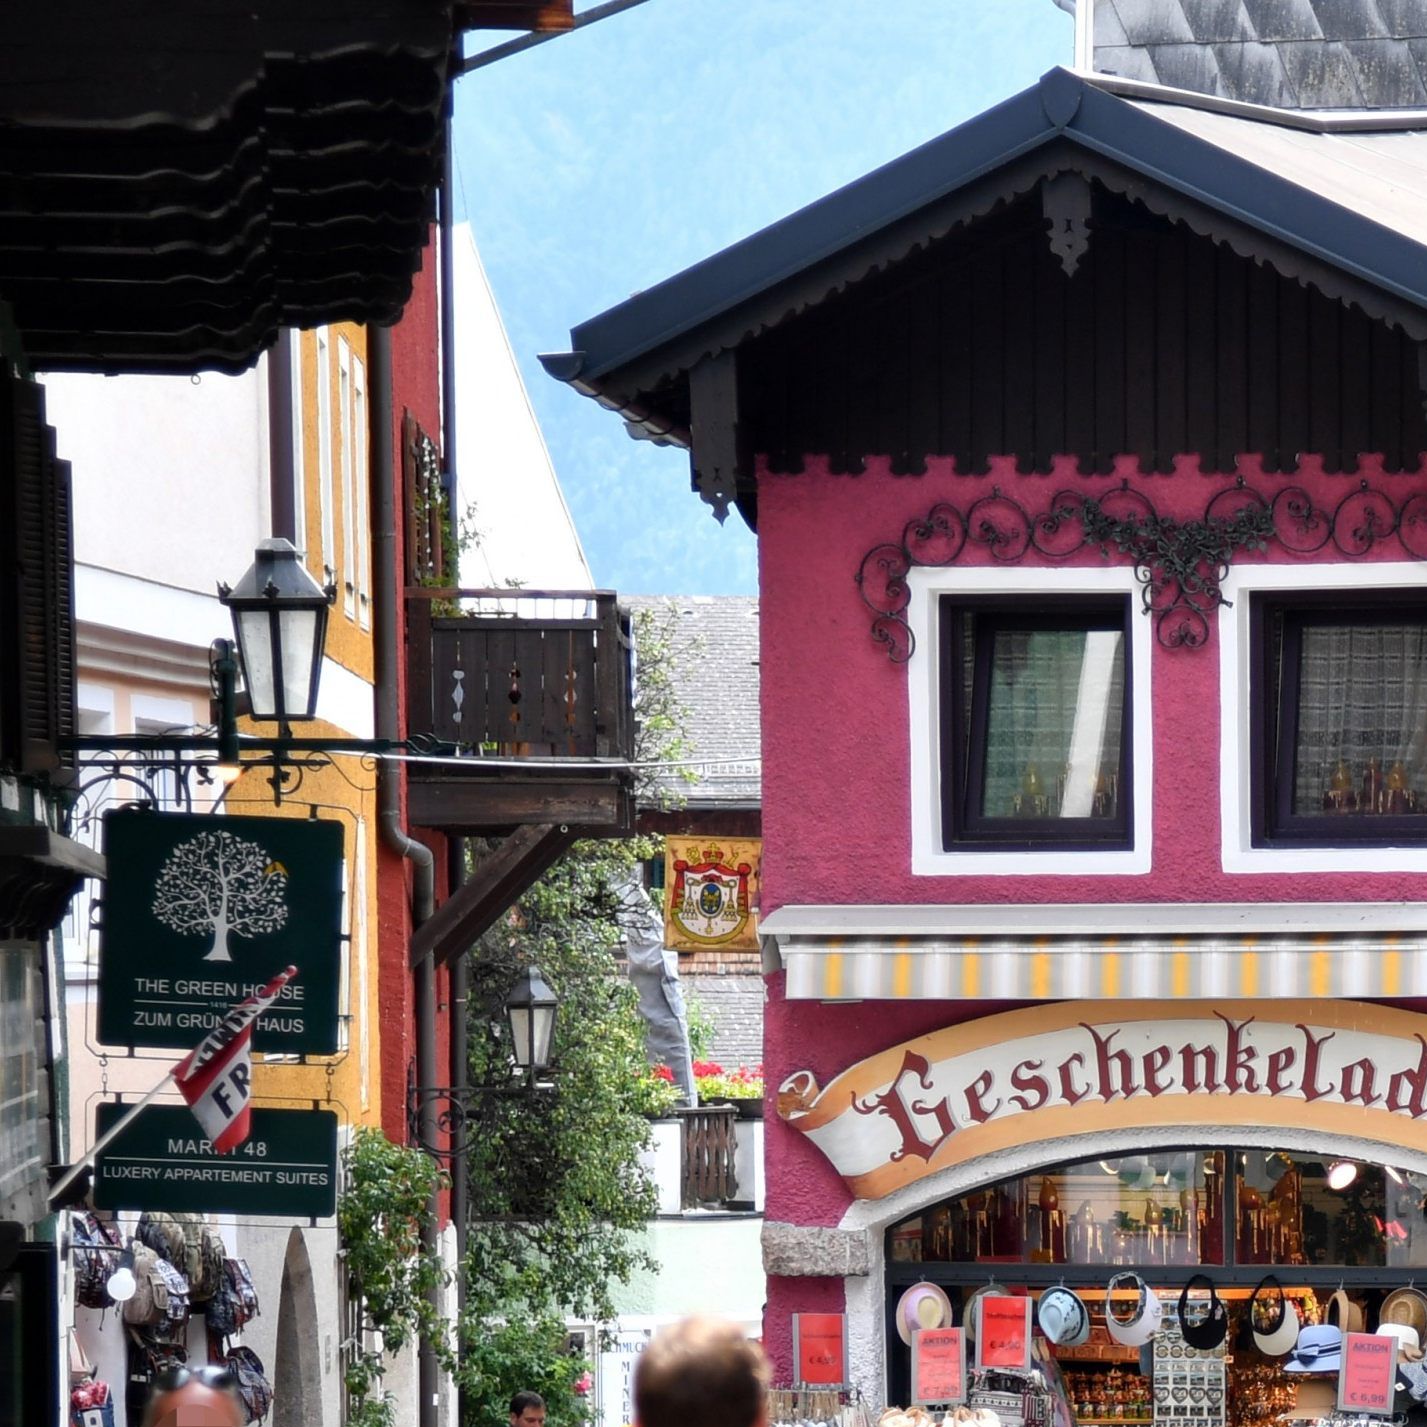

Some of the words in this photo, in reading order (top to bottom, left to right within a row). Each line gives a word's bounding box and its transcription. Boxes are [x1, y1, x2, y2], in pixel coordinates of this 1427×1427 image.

[134, 978, 169, 994] THE
[175, 980, 237, 997] GREEN
[133, 1011, 172, 1027] ZUM
[176, 1012, 225, 1029] GRÜN
[256, 1017, 304, 1033] HAUS
[244, 1141, 267, 1157] 48
[103, 1165, 161, 1179] LUXERY
[163, 1167, 272, 1183] APPARTEMENT
[275, 1171, 328, 1185] SUITES
[1353, 1342, 1388, 1353] AKTION
